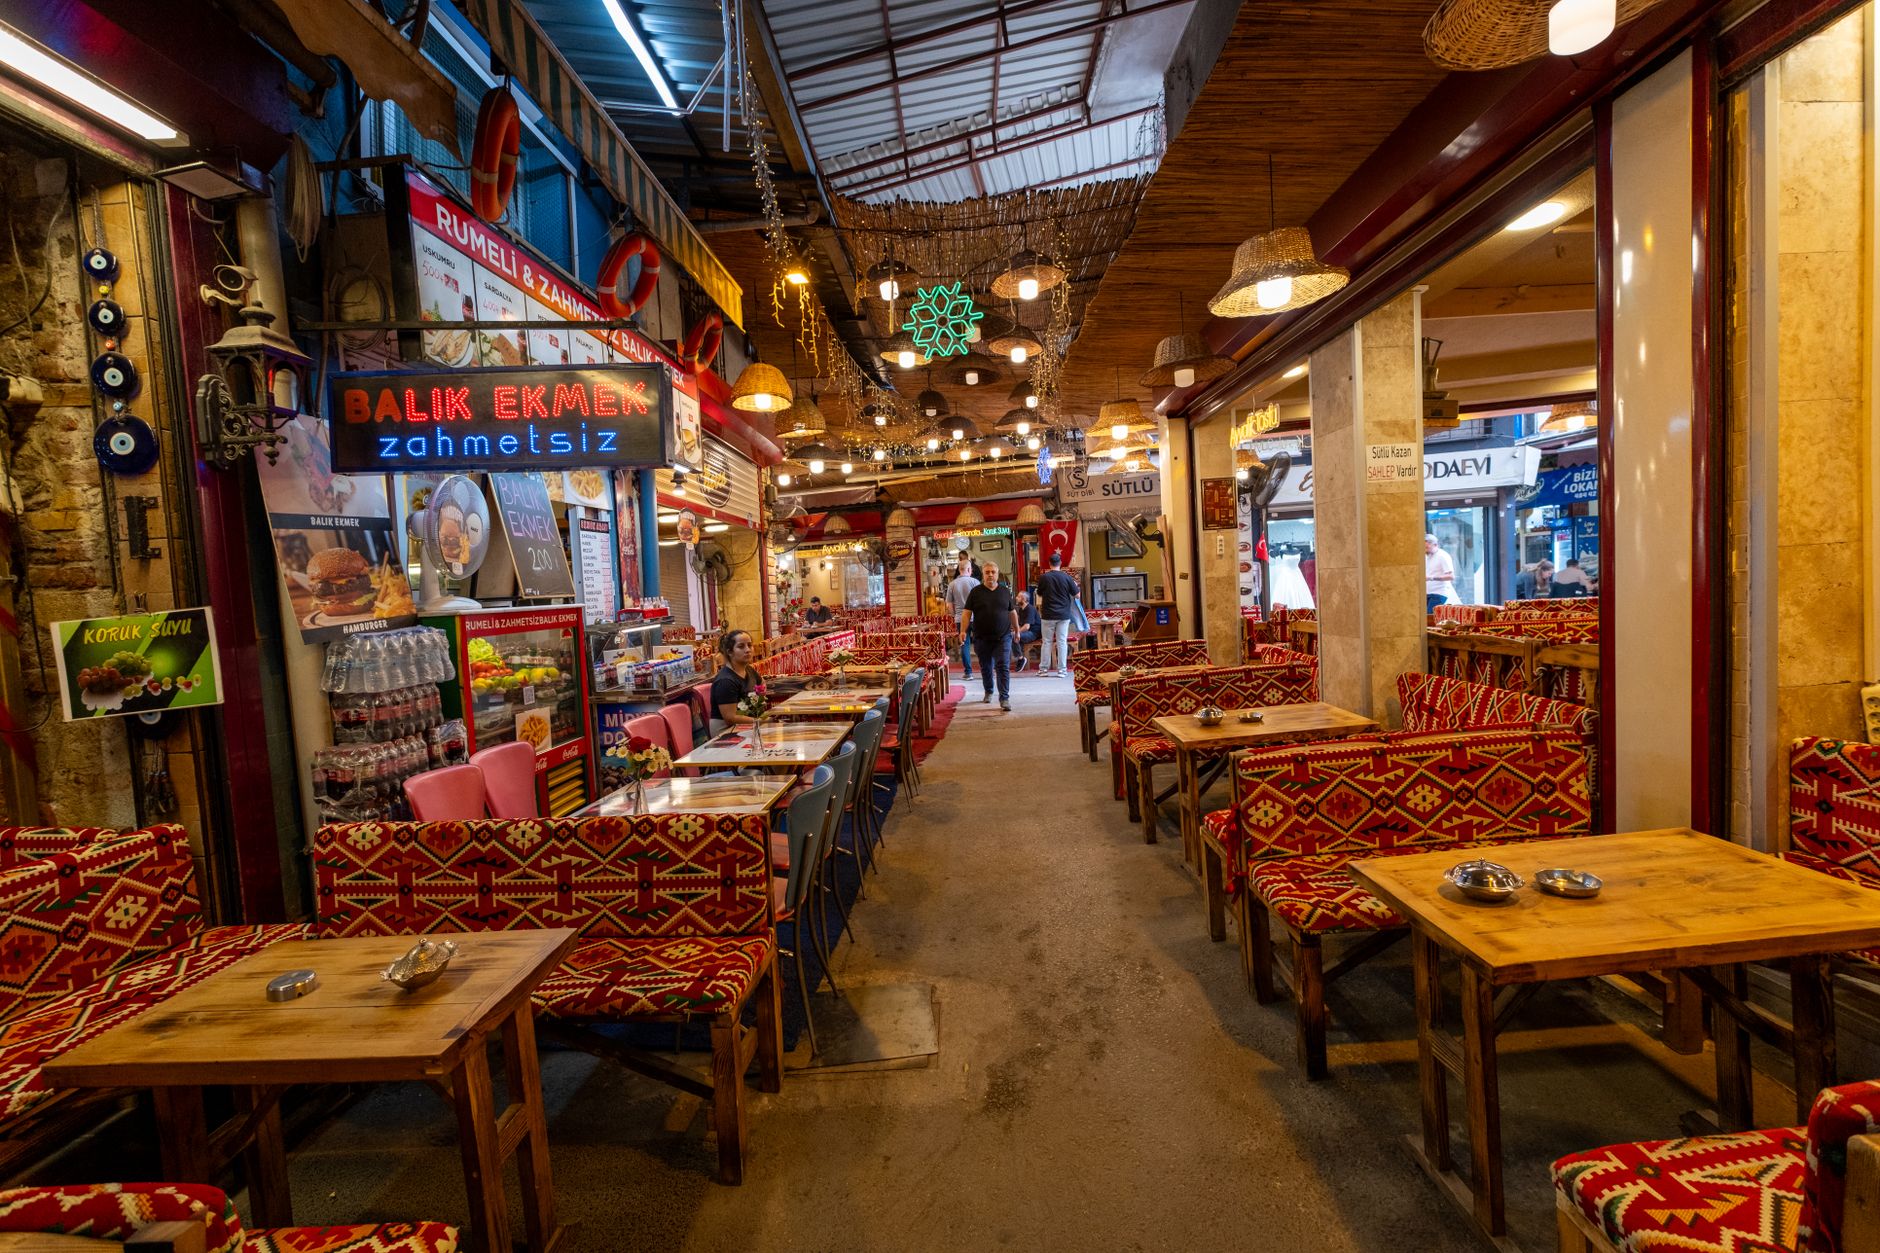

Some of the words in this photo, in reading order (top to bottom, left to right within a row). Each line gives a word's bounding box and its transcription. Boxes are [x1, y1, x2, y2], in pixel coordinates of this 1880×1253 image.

[422, 244, 456, 269] USKUMRU
[436, 203, 517, 279] RUMELİ
[523, 264, 535, 290] &
[484, 281, 513, 303] SARDALYA
[344, 386, 474, 423] BALIK
[493, 381, 649, 420] EKMEK
[379, 423, 618, 457] zahmetsiz
[1372, 446, 1390, 459] Sütlü
[1390, 446, 1412, 458] Kazan
[1368, 465, 1395, 479] SAHLEP
[1396, 464, 1417, 477] Vardır
[1573, 466, 1597, 482] BİZİ
[498, 476, 547, 512] BALIK
[1102, 476, 1153, 497] SÜTLÜ
[1564, 480, 1597, 494] LOKA
[310, 516, 333, 527] BALIK
[335, 518, 360, 528] EKMEK
[507, 510, 555, 542] EKMEK
[528, 547, 553, 571] 200
[83, 625, 142, 644] KORUK
[150, 618, 192, 638] SUYU
[343, 619, 388, 634] HAMBURGER
[465, 617, 494, 631] RUMELİ
[558, 613, 578, 623] EKMEK
